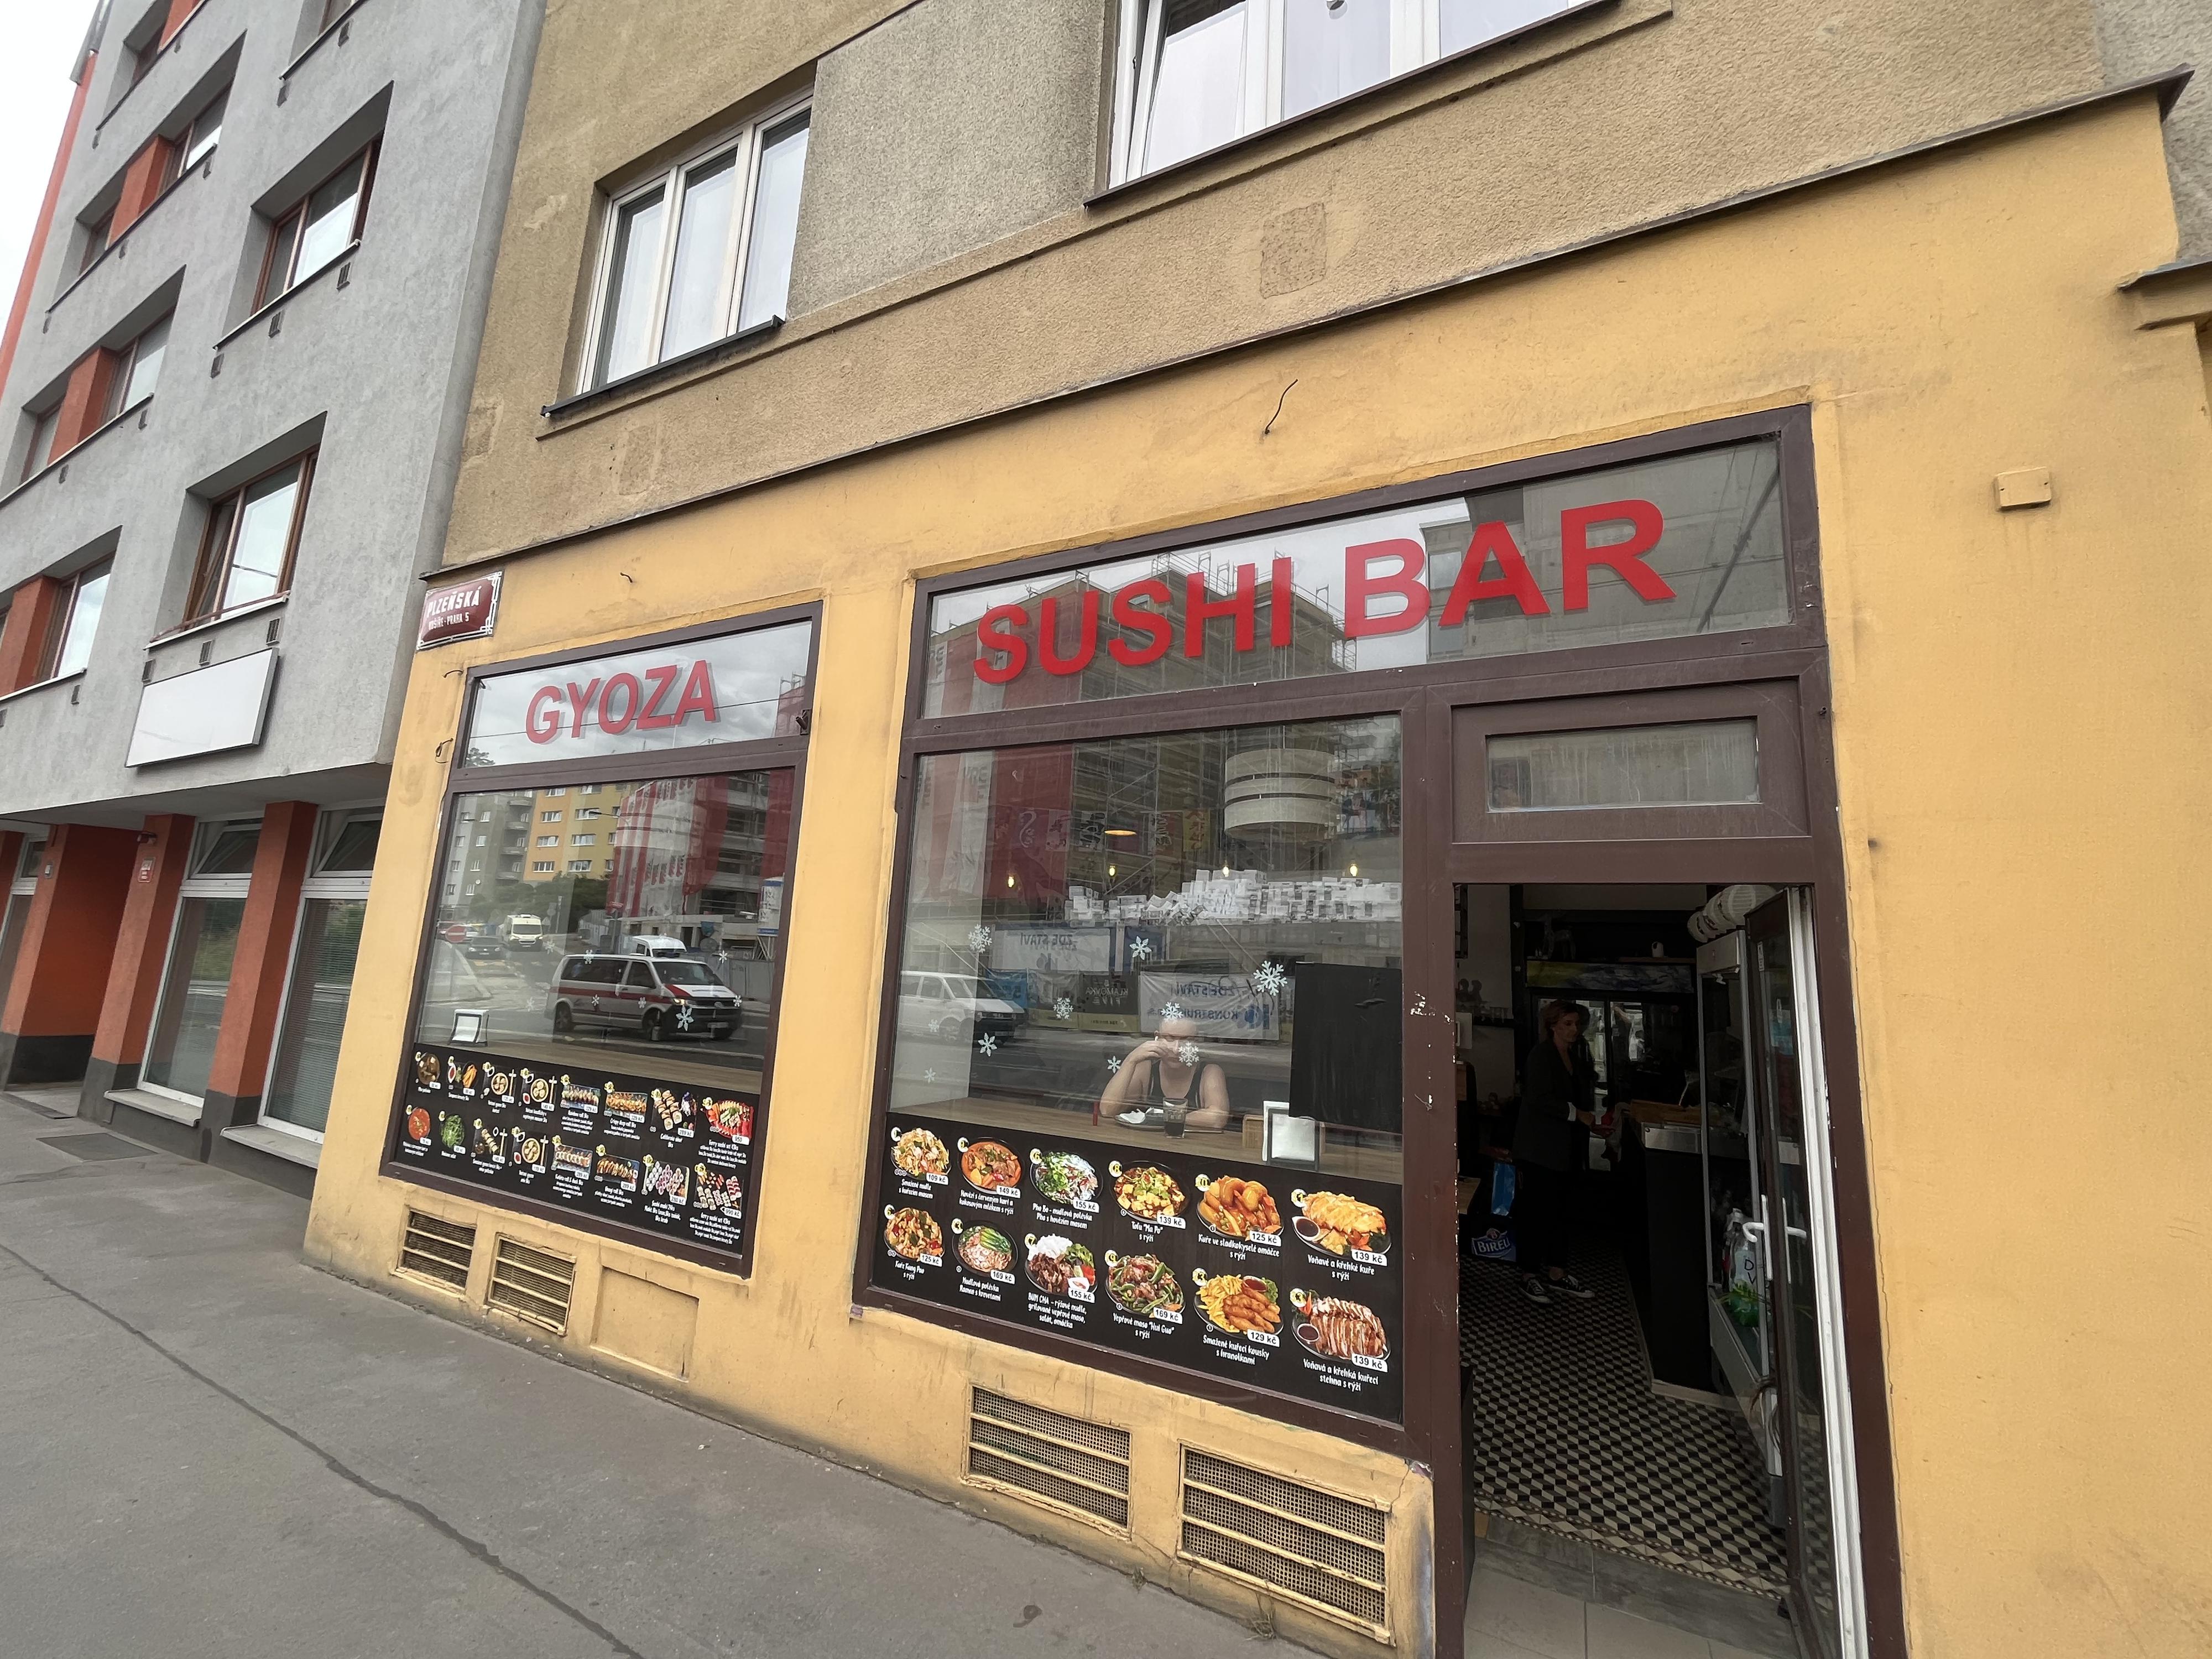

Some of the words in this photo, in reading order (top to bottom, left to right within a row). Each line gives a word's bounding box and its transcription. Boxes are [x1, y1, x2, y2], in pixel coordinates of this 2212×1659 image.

[974, 558, 1291, 684] SUSHI
[1345, 499, 1677, 637] BAR
[427, 586, 482, 618] PLZEŇSKÁ
[465, 612, 469, 622] 5
[525, 660, 716, 744] GYOZA
[1032, 1202, 1042, 1212] Pho
[1042, 1204, 1049, 1213] Bo
[1076, 1201, 1086, 1209] 155
[1036, 1212, 1046, 1221] Pho
[1070, 1220, 1087, 1229] masem
[1131, 1221, 1142, 1230] Tofu
[1143, 1233, 1154, 1243] rýží
[1252, 1233, 1266, 1241] 125
[1268, 1235, 1277, 1244] kč
[1198, 1234, 1211, 1244] Kuře
[1219, 1238, 1256, 1253] sladkokyselé
[1258, 1246, 1280, 1257] omáčce
[1234, 1251, 1246, 1261] rýží
[1355, 1251, 1369, 1261] 139
[1373, 1255, 1383, 1264] kč
[1307, 1254, 1329, 1266] Voňavé
[1336, 1259, 1358, 1272] křehké
[1359, 1264, 1375, 1275] kuře
[1744, 1259, 1754, 1271] D
[1337, 1271, 1349, 1282] rýží
[959, 1284, 974, 1295] Ramen
[1071, 1290, 1082, 1298] 155
[1083, 1292, 1092, 1301] kč
[1071, 1313, 1086, 1324] maso,
[1113, 1312, 1133, 1324] Vepřové
[1134, 1319, 1148, 1329] maso
[1156, 1309, 1167, 1318] 169
[1170, 1313, 1178, 1321] kč
[1139, 1330, 1150, 1340] rýží
[1251, 1332, 1265, 1341] 129
[1267, 1335, 1276, 1344] kč
[1203, 1334, 1228, 1348] Smažené
[1229, 1340, 1247, 1353] kuřecí
[1248, 1345, 1270, 1360] kousky
[1220, 1348, 1255, 1365] hranolkami
[1354, 1355, 1369, 1366] 139
[1372, 1359, 1383, 1369] kč
[1303, 1358, 1326, 1373] Voňavá
[1333, 1365, 1357, 1380] křehká
[1358, 1371, 1379, 1385] kuřecí
[1319, 1374, 1342, 1387] stehna
[1347, 1381, 1361, 1392] rýží
